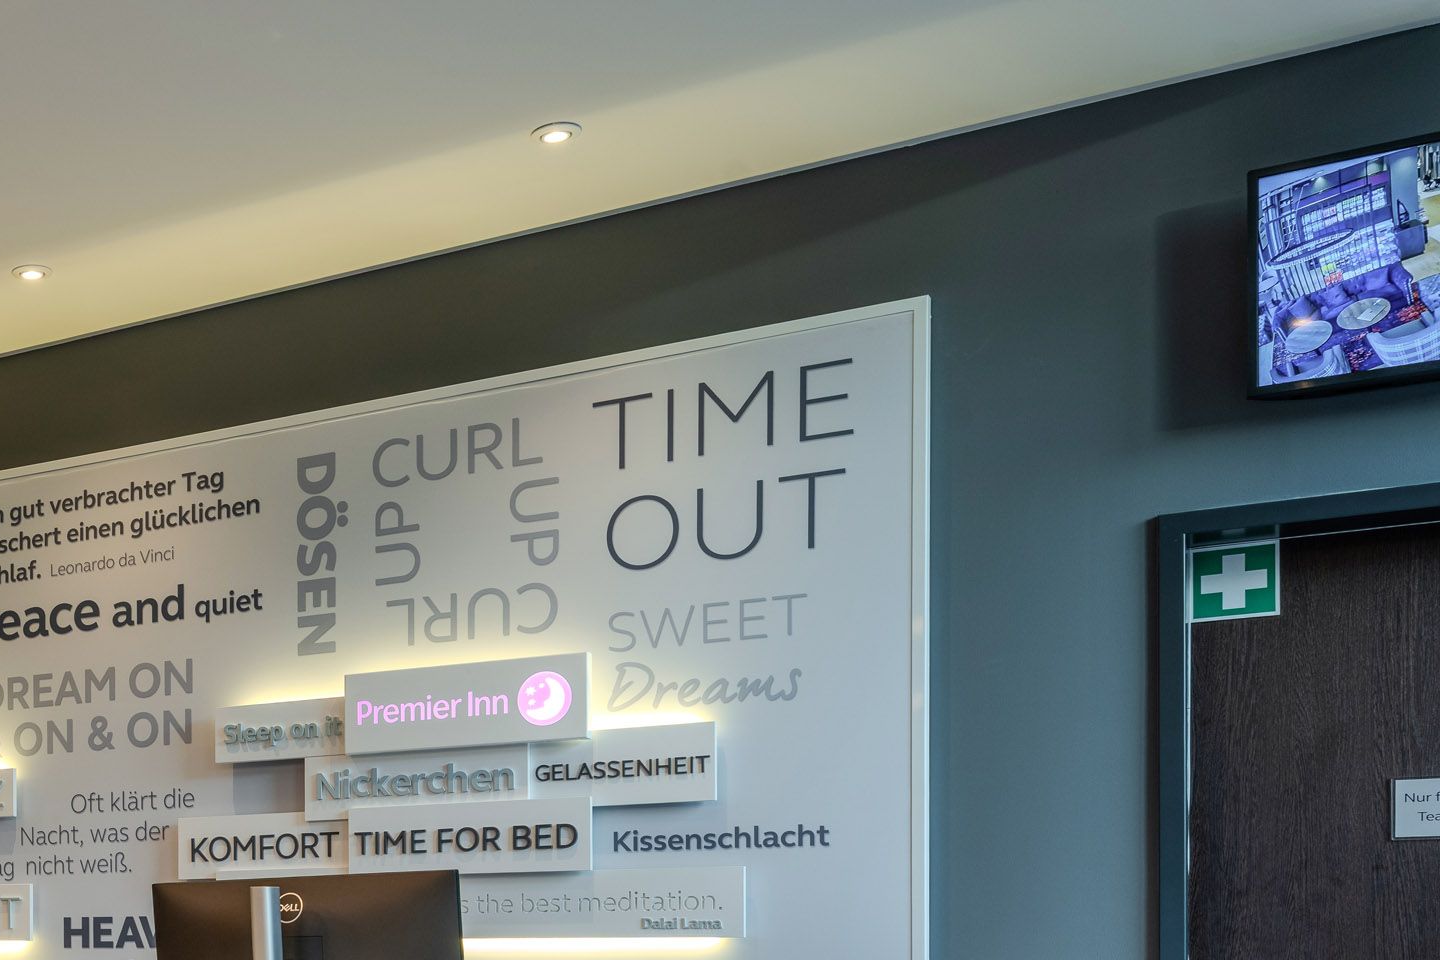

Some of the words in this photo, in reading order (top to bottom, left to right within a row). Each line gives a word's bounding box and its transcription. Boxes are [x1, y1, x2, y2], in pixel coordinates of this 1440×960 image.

[592, 357, 854, 470] TIME
[371, 416, 544, 490] CURL
[10, 498, 45, 526] gut
[49, 477, 176, 516] verbrachter
[182, 469, 225, 495] Tag
[67, 519, 124, 544] einen
[130, 497, 261, 539] glücklichen
[509, 475, 560, 567] UP
[606, 467, 846, 571] OUT
[50, 554, 115, 578] Leonardo
[118, 551, 136, 568] da
[140, 545, 176, 564] Vinci
[296, 451, 349, 657] DÖSEN
[374, 501, 421, 587] UP
[112, 584, 185, 628] and
[194, 587, 263, 623] quiet
[386, 582, 558, 647] CURL
[608, 592, 807, 653] SWEET
[128, 658, 194, 699] ON
[606, 661, 803, 713] Dreams
[355, 697, 462, 726] Premier
[467, 691, 509, 717] Inn
[13, 718, 74, 757] ON
[87, 715, 115, 752] &
[126, 708, 193, 749] ON
[223, 721, 284, 747] Sleep
[289, 723, 320, 740] on
[325, 714, 343, 737] it
[315, 763, 515, 802] Nickerchen
[535, 754, 711, 783] GELASSENHEIT
[70, 791, 105, 815] Oft
[110, 788, 158, 813] klärt
[163, 787, 196, 809] die
[1404, 792, 1432, 803] Nur
[20, 823, 84, 849] Nacht,
[90, 824, 129, 844] was
[135, 820, 170, 841] der
[1417, 811, 1440, 822] Tea
[190, 831, 340, 863] KOMFORT
[354, 829, 428, 857] TIME
[437, 825, 502, 853] FOR
[512, 822, 579, 852] BED
[613, 823, 830, 853] Kissenschlacht
[26, 855, 74, 876] nicht
[79, 851, 132, 875] weiß.
[477, 893, 513, 914] the
[521, 892, 572, 914] best
[578, 890, 723, 914] meditation.
[63, 915, 157, 949] HEAV
[640, 917, 678, 931] Dalai
[680, 916, 723, 931] Lama
